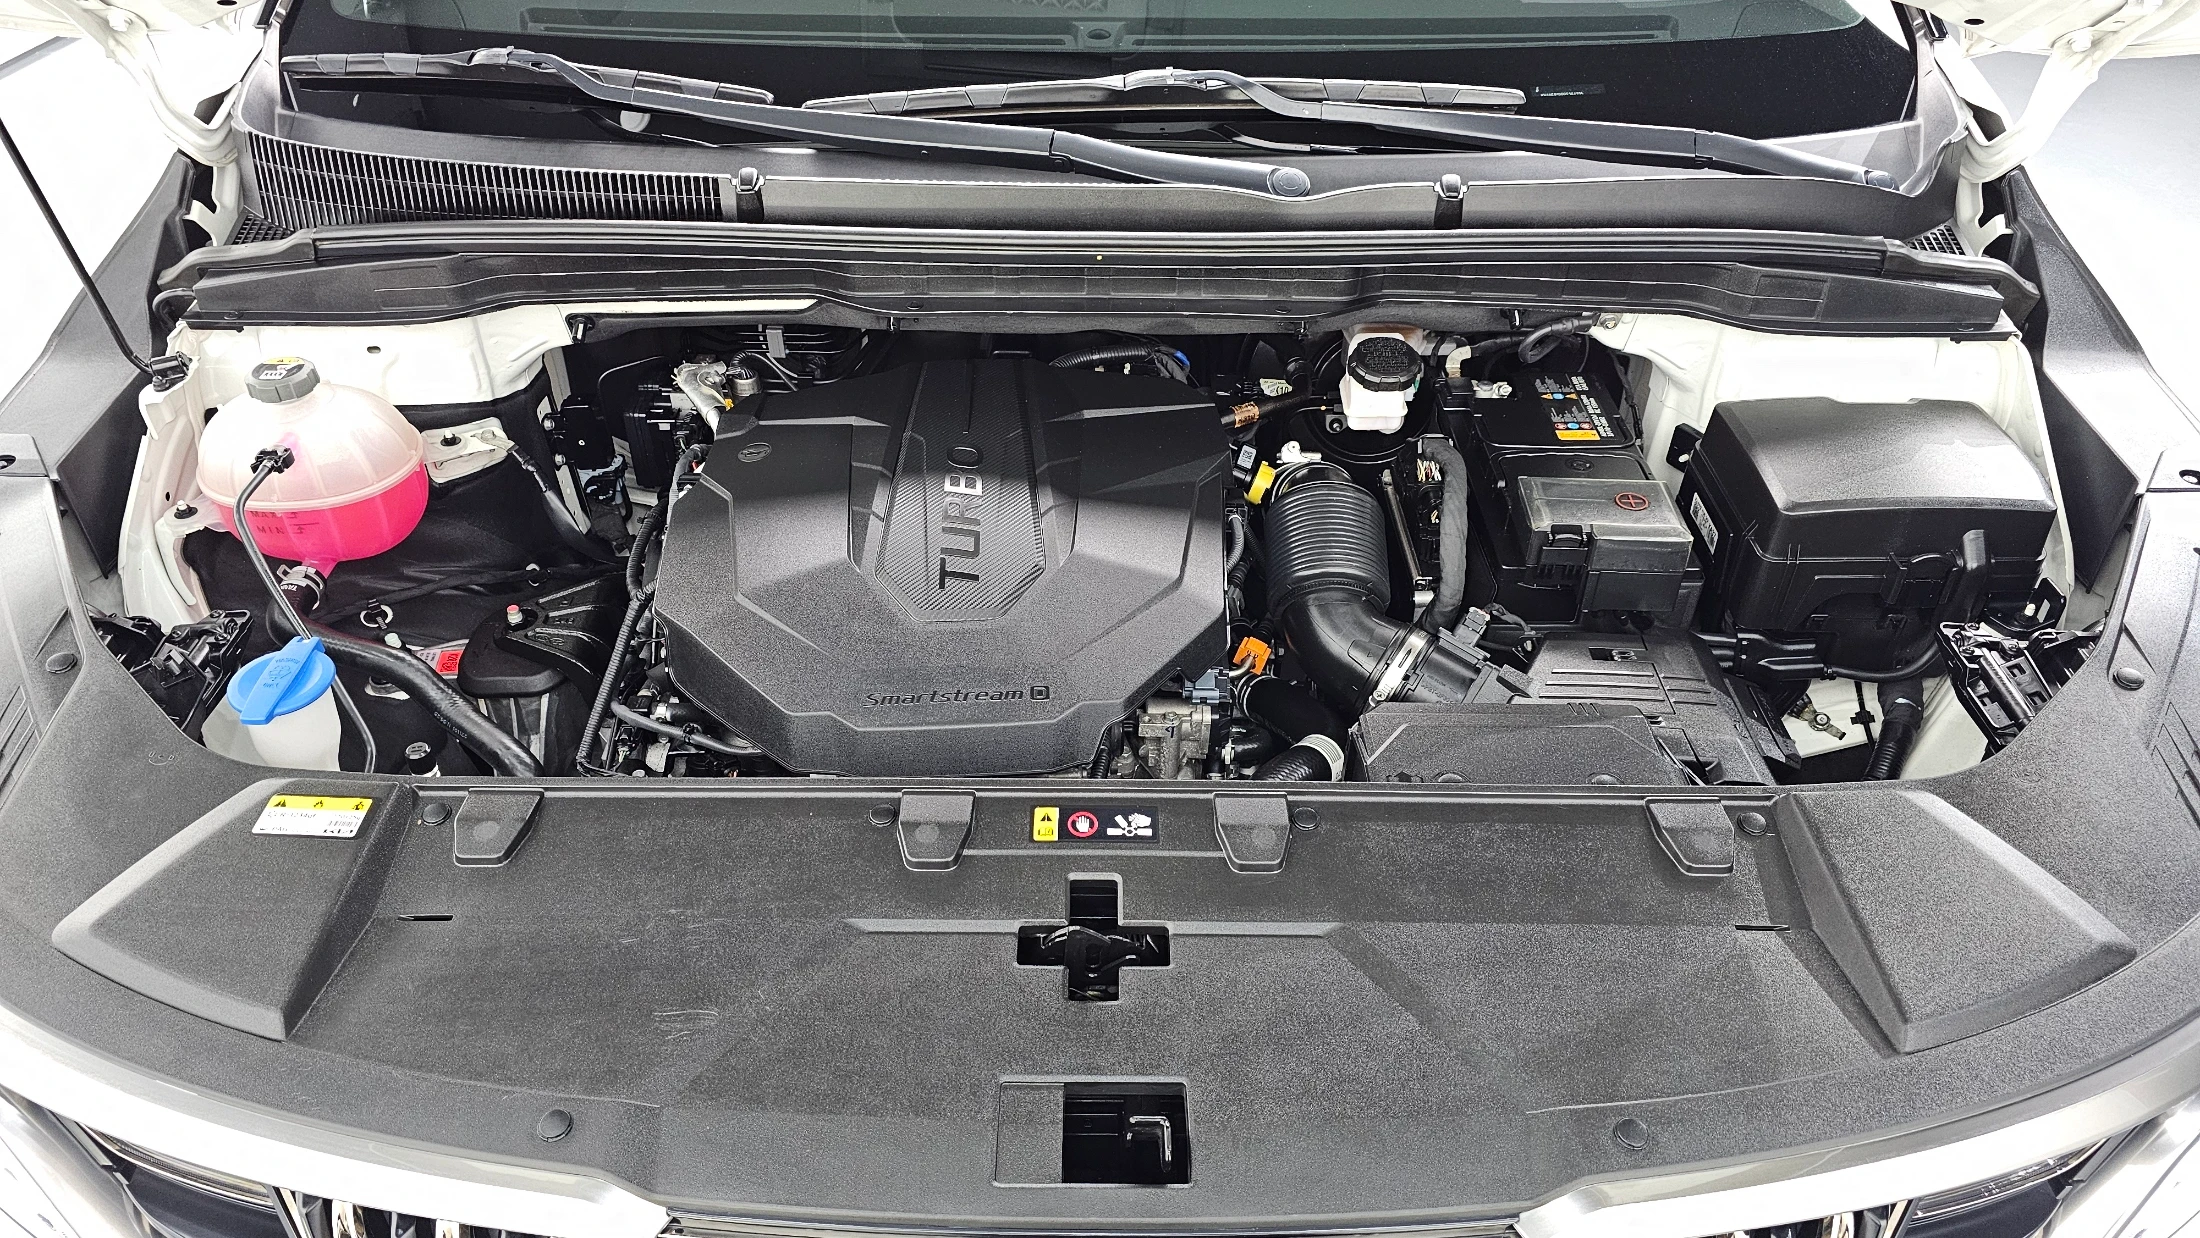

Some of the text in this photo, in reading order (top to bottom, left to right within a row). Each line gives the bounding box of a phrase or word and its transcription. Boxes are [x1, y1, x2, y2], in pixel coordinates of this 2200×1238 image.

[939, 446, 983, 590] TURBO
[256, 525, 285, 535] MIN
[863, 689, 1024, 708] Smartstream
